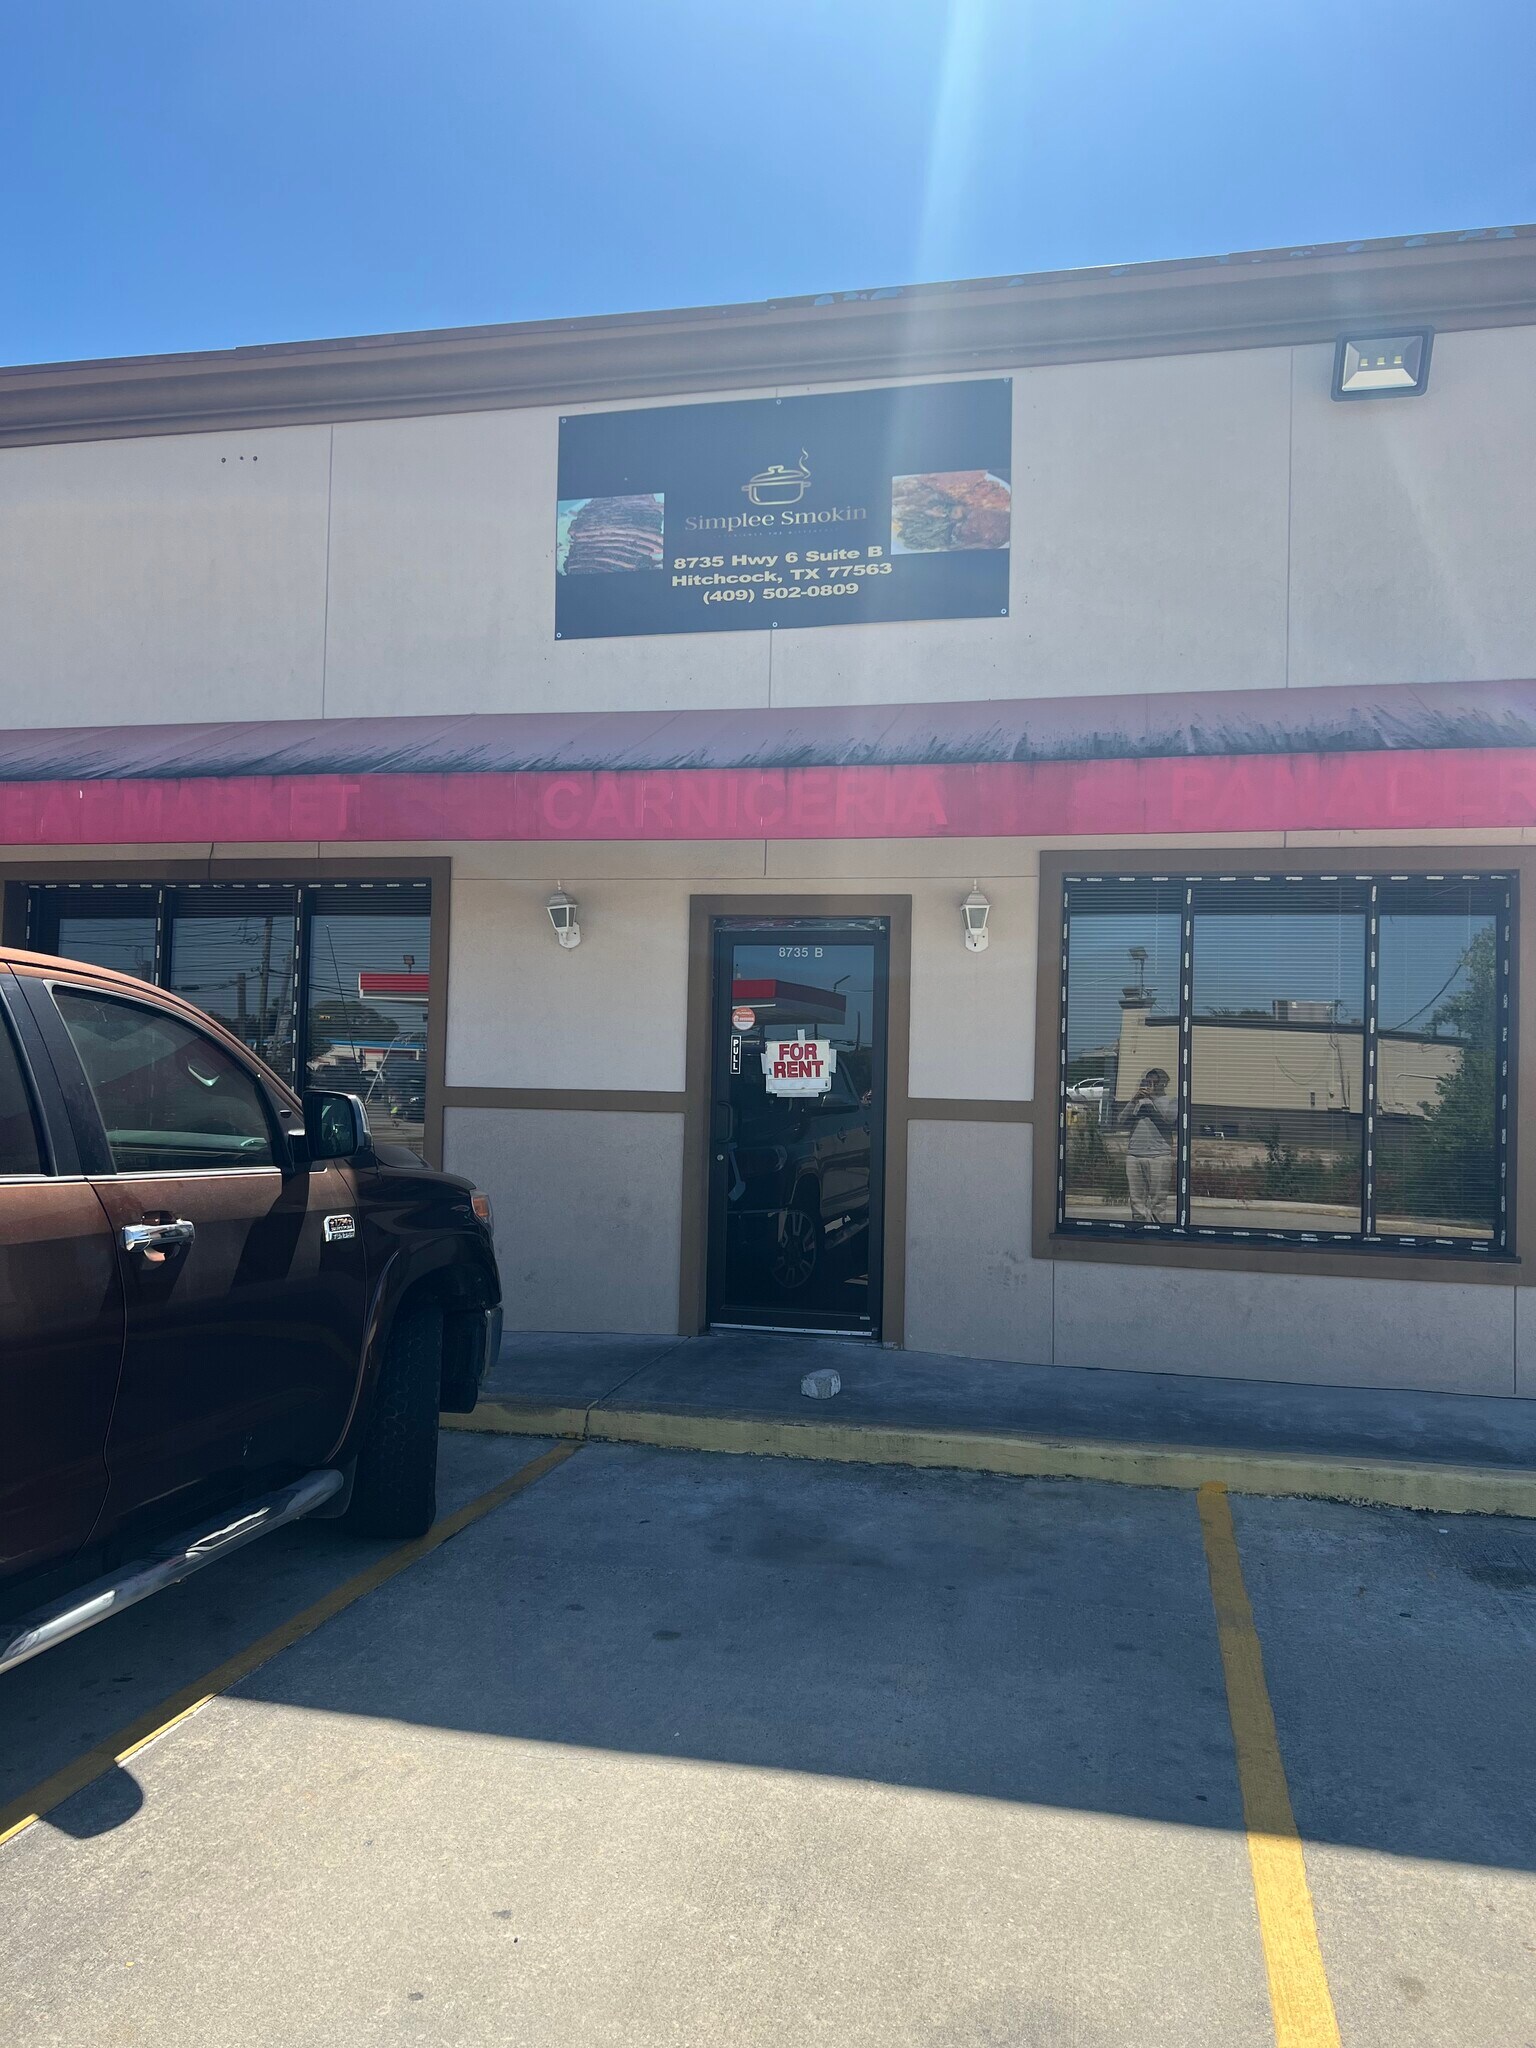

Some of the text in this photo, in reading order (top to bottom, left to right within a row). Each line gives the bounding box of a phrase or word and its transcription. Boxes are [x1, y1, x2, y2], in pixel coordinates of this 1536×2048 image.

[684, 505, 868, 533] Simplee Smokin
[673, 545, 884, 569] 8735 Hwy 6 Suite B
[671, 562, 893, 588] Hitchcock, TX 77563
[702, 582, 860, 604] (409) 502-0809
[541, 767, 949, 830] CARNICERIA
[778, 946, 824, 958] 8735 B
[732, 1039, 740, 1071] PULL
[778, 1042, 818, 1061] FOR
[773, 1060, 824, 1079] RENT
